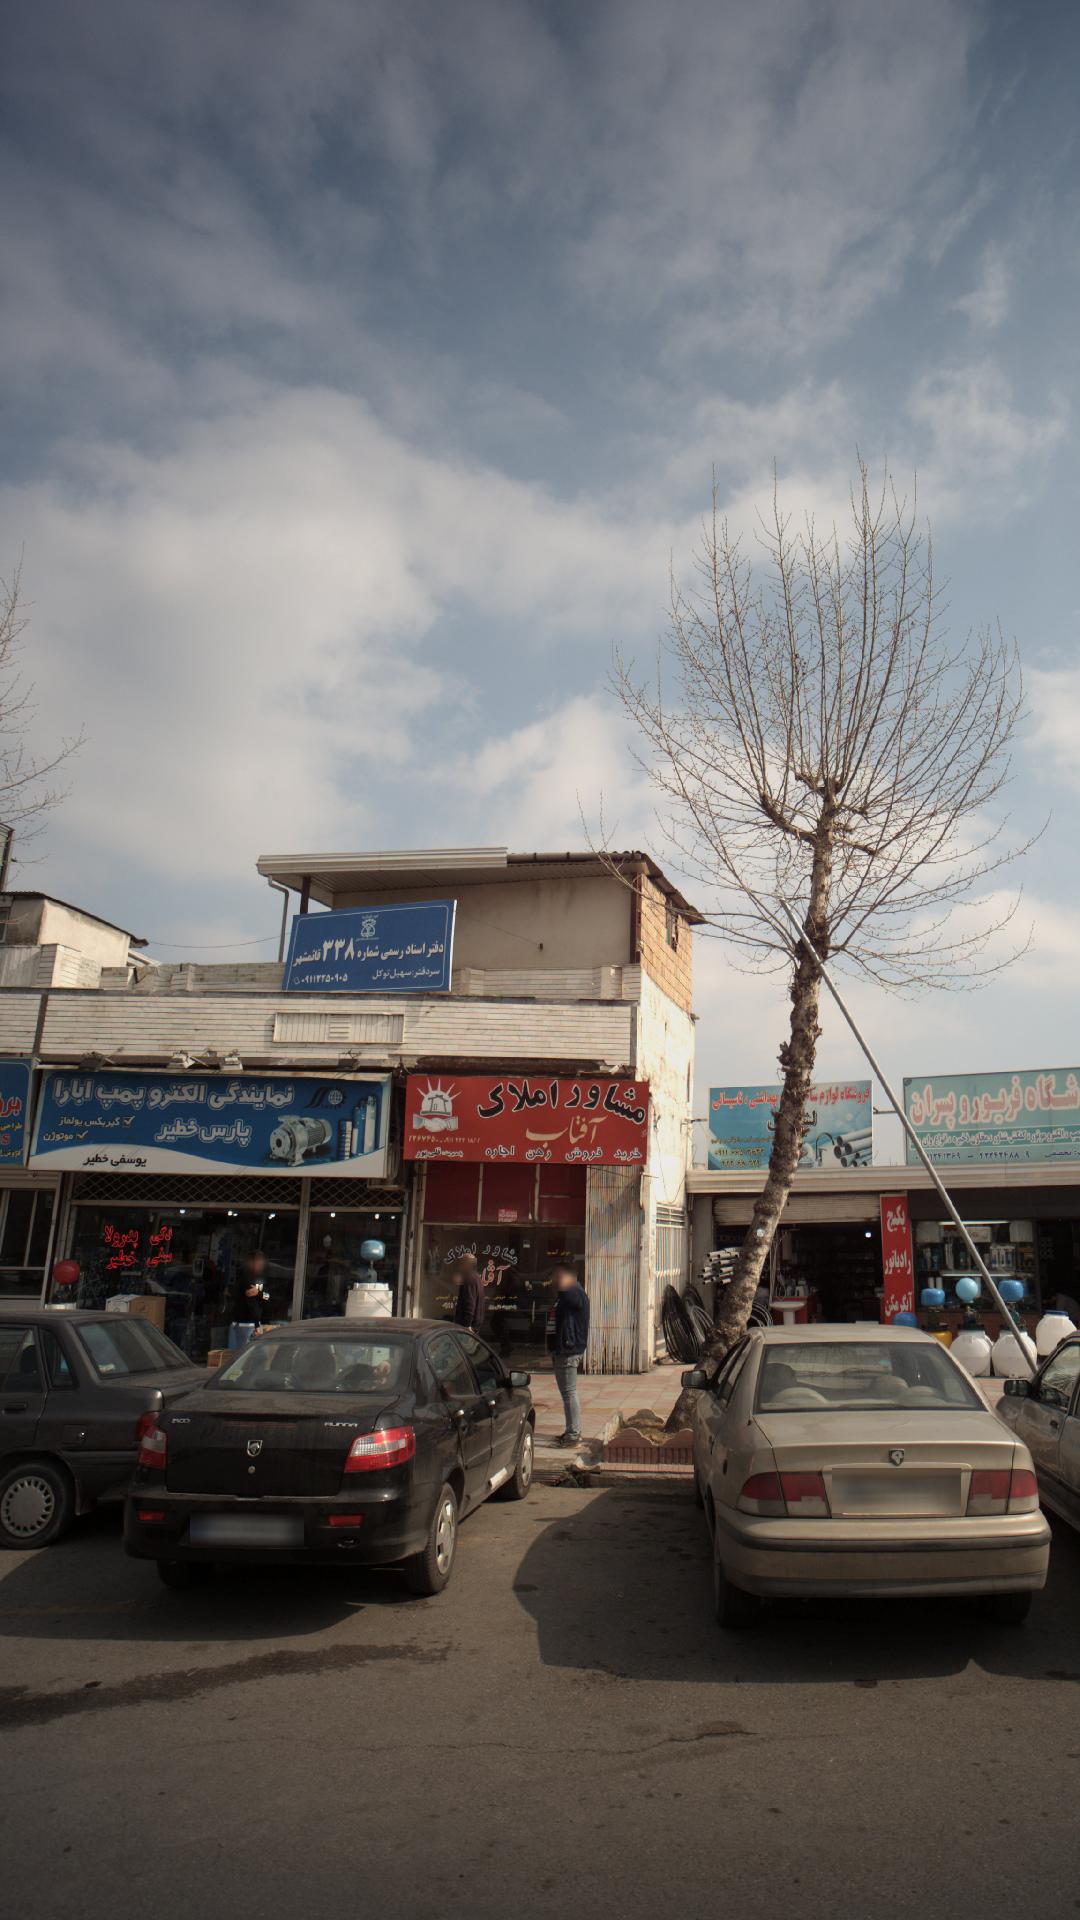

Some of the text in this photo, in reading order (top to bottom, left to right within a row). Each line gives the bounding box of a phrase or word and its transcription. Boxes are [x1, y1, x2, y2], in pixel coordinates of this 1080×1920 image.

[322, 937, 355, 963] ۳۳۸
[357, 945, 379, 961] شماره
[380, 948, 404, 961] رسمی
[406, 942, 425, 955] اسناد
[427, 940, 444, 957] دفتر
[54, 1078, 294, 1110] نمایندگی الکترو پمپ ابارا
[564, 1082, 646, 1125] مشاور
[818, 1086, 839, 1106] لوازم
[840, 1085, 871, 1106] فروشگاه
[910, 1084, 956, 1130] پسران
[959, 1094, 970, 1125] و
[155, 1117, 253, 1147] پارس خطیر
[525, 1114, 608, 1148] آفتاب
[82, 1153, 147, 1168] یوسفی خطیر
[485, 1145, 515, 1159] اجاره
[525, 1146, 552, 1161] رهن
[565, 1147, 603, 1161] فروش
[613, 1147, 643, 1161] خرید
[886, 1203, 906, 1233] پکیج
[884, 1249, 911, 1275] رادیاتور
